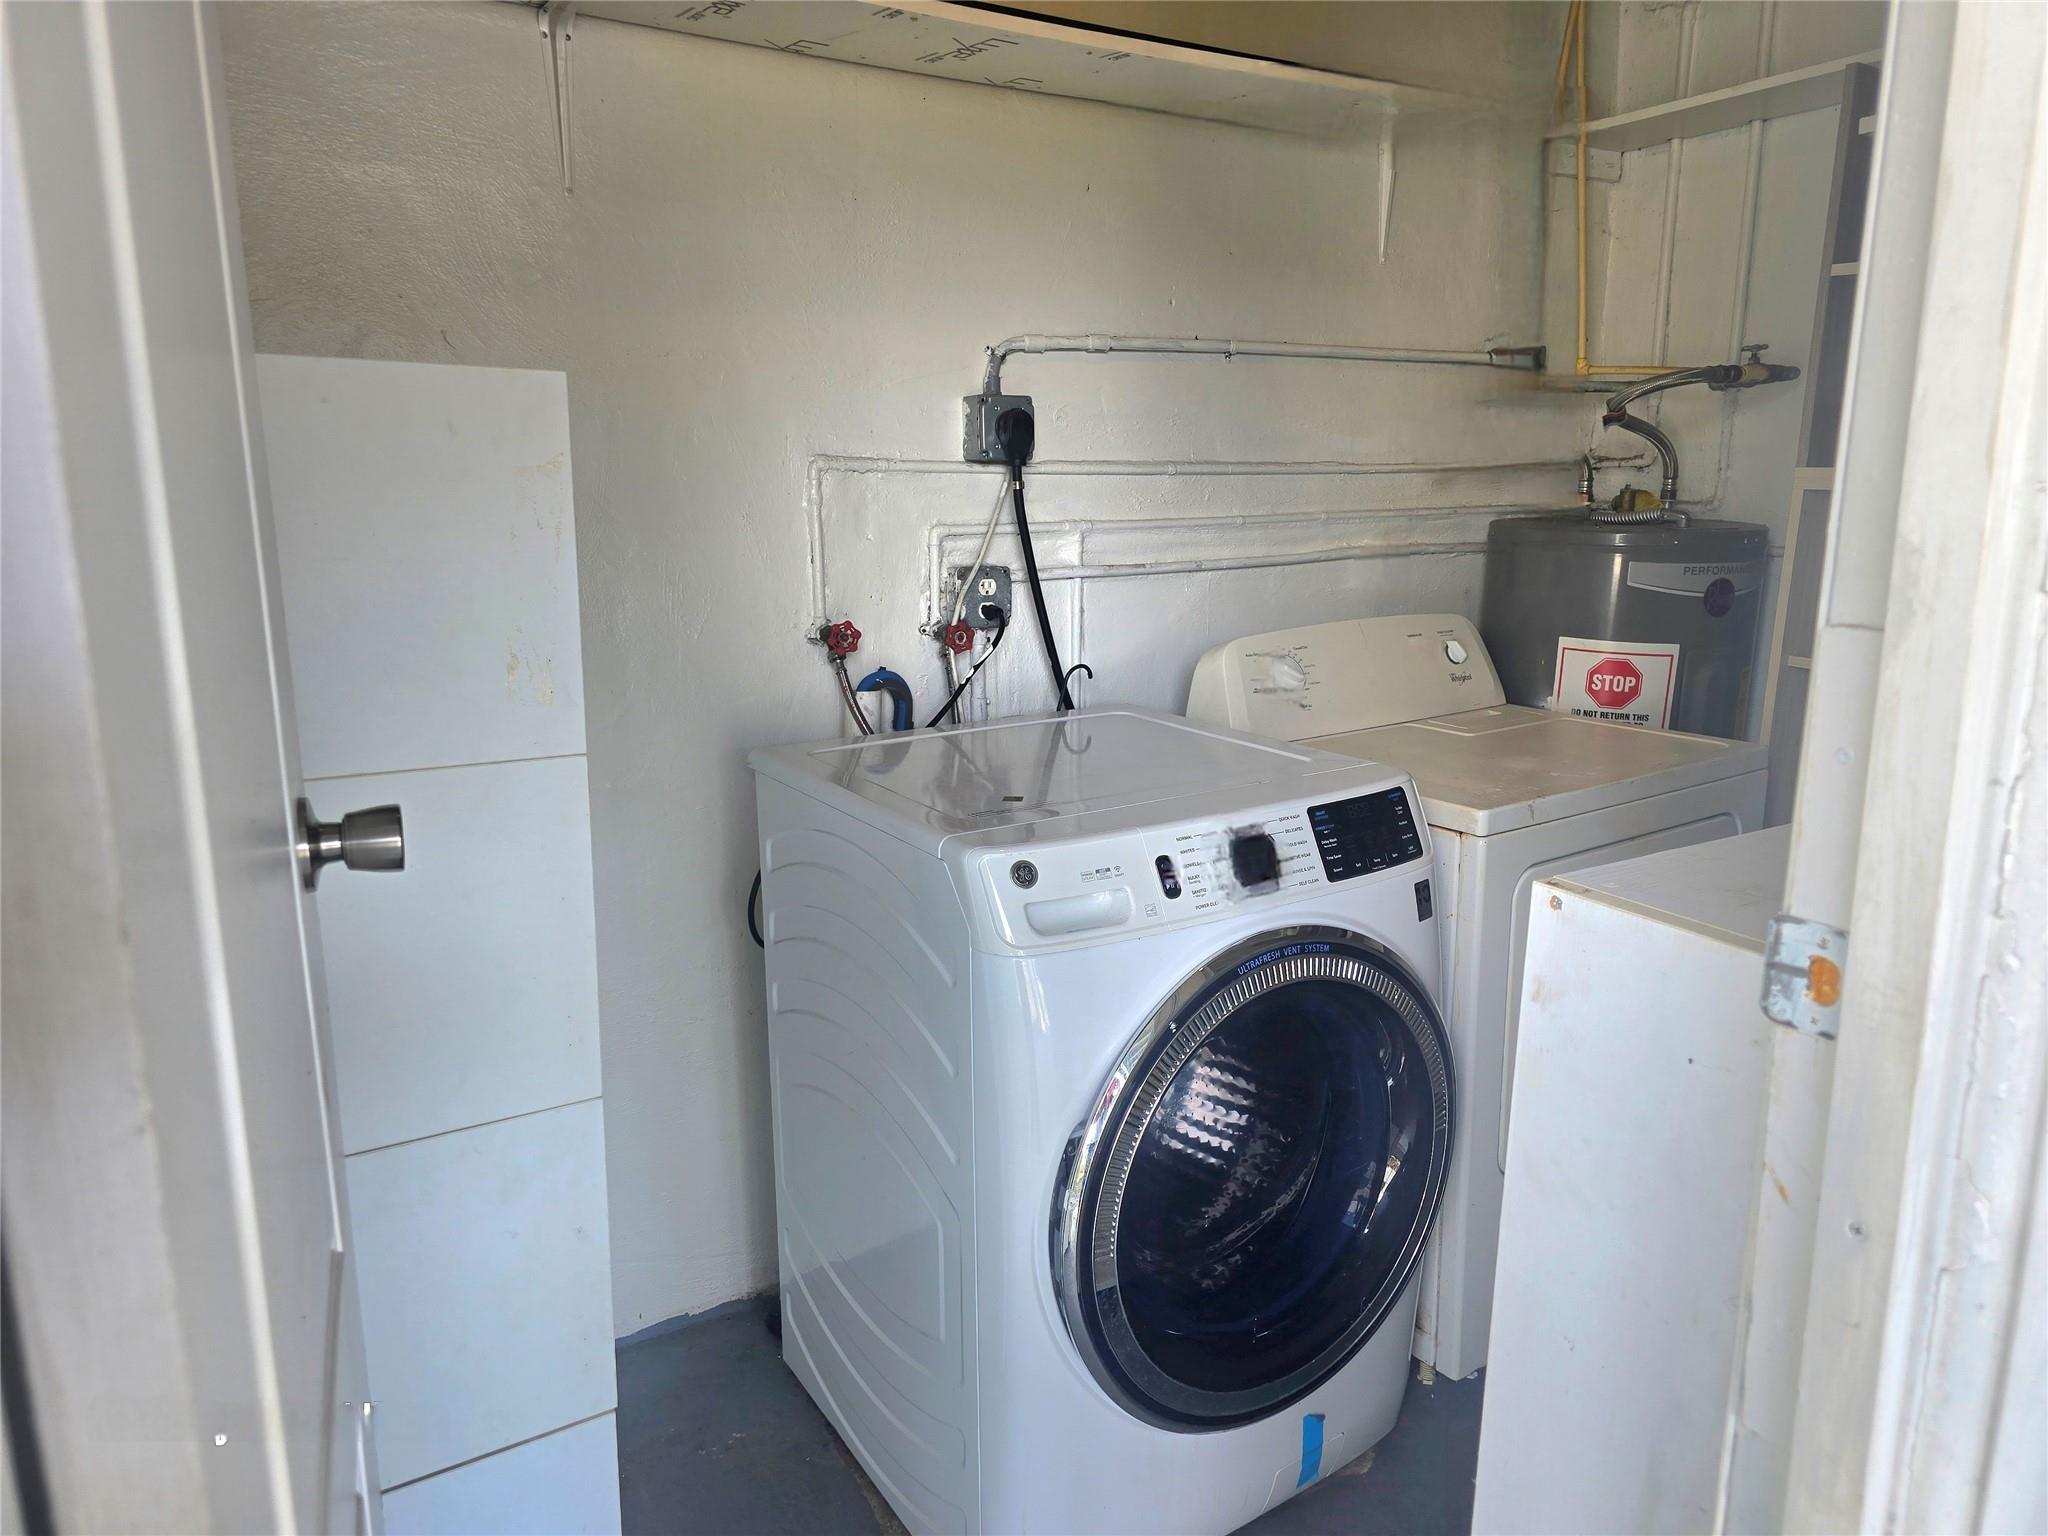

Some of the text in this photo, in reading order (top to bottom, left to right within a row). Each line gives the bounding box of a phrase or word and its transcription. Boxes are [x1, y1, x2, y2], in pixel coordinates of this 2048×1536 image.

[1591, 673, 1636, 693] STOP
[1571, 708, 1650, 722] DO NOT RETURN THIS
[1237, 943, 1330, 975] ULTRAFRESH VENT SYSTEM
